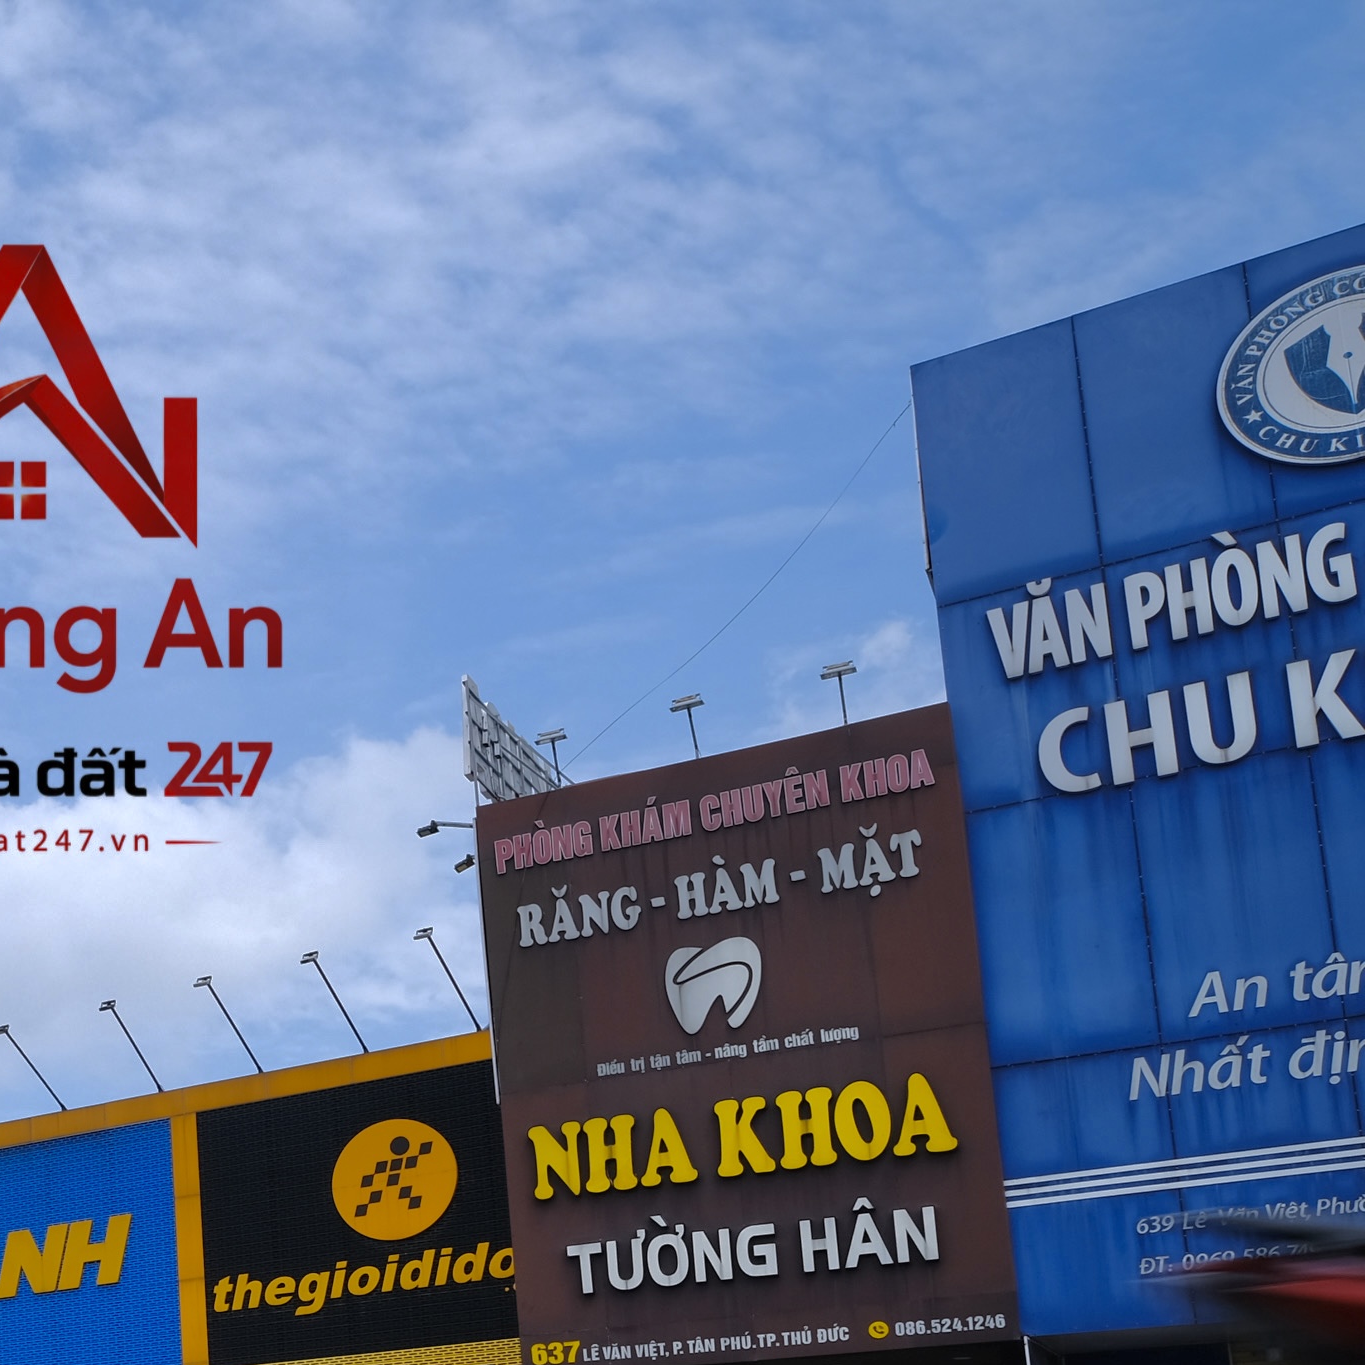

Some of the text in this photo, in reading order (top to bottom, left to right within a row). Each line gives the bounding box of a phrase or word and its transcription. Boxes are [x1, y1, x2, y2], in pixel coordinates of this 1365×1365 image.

[1230, 291, 1324, 406] VĂN PHÒNG
[1258, 425, 1319, 453] CHU
[985, 521, 1359, 681] VĂN PHÒNG
[1037, 670, 1259, 794] CHU
[493, 747, 936, 875] PHÒNG KHÁM CHUYÊN KHOA
[515, 822, 923, 949] RĂNG HÀM MẶT
[1188, 970, 1269, 1018] An
[630, 1056, 646, 1074] trị
[650, 1053, 670, 1070] tận
[676, 1049, 702, 1065] tâm
[714, 1043, 747, 1059] nâng
[784, 1029, 815, 1048] chất
[820, 1025, 860, 1045] lượng
[1128, 1033, 1270, 1102] Nhất
[526, 1071, 959, 1201] NHA KHOA
[566, 1196, 940, 1295] TƯỜNG HÂN
[1136, 1214, 1175, 1235] 639
[1182, 1211, 1207, 1231] Lê
[212, 1241, 515, 1316] thegioidido
[530, 1339, 581, 1365] 637
[582, 1344, 601, 1362] LÊ
[602, 1345, 632, 1361] VĂN
[635, 1340, 670, 1360] VIỆT,
[672, 1341, 685, 1355] P.
[686, 1337, 716, 1354] TÂN
[817, 1323, 850, 1343] ĐỨC
[894, 1313, 1006, 1337] 086.524.1246
